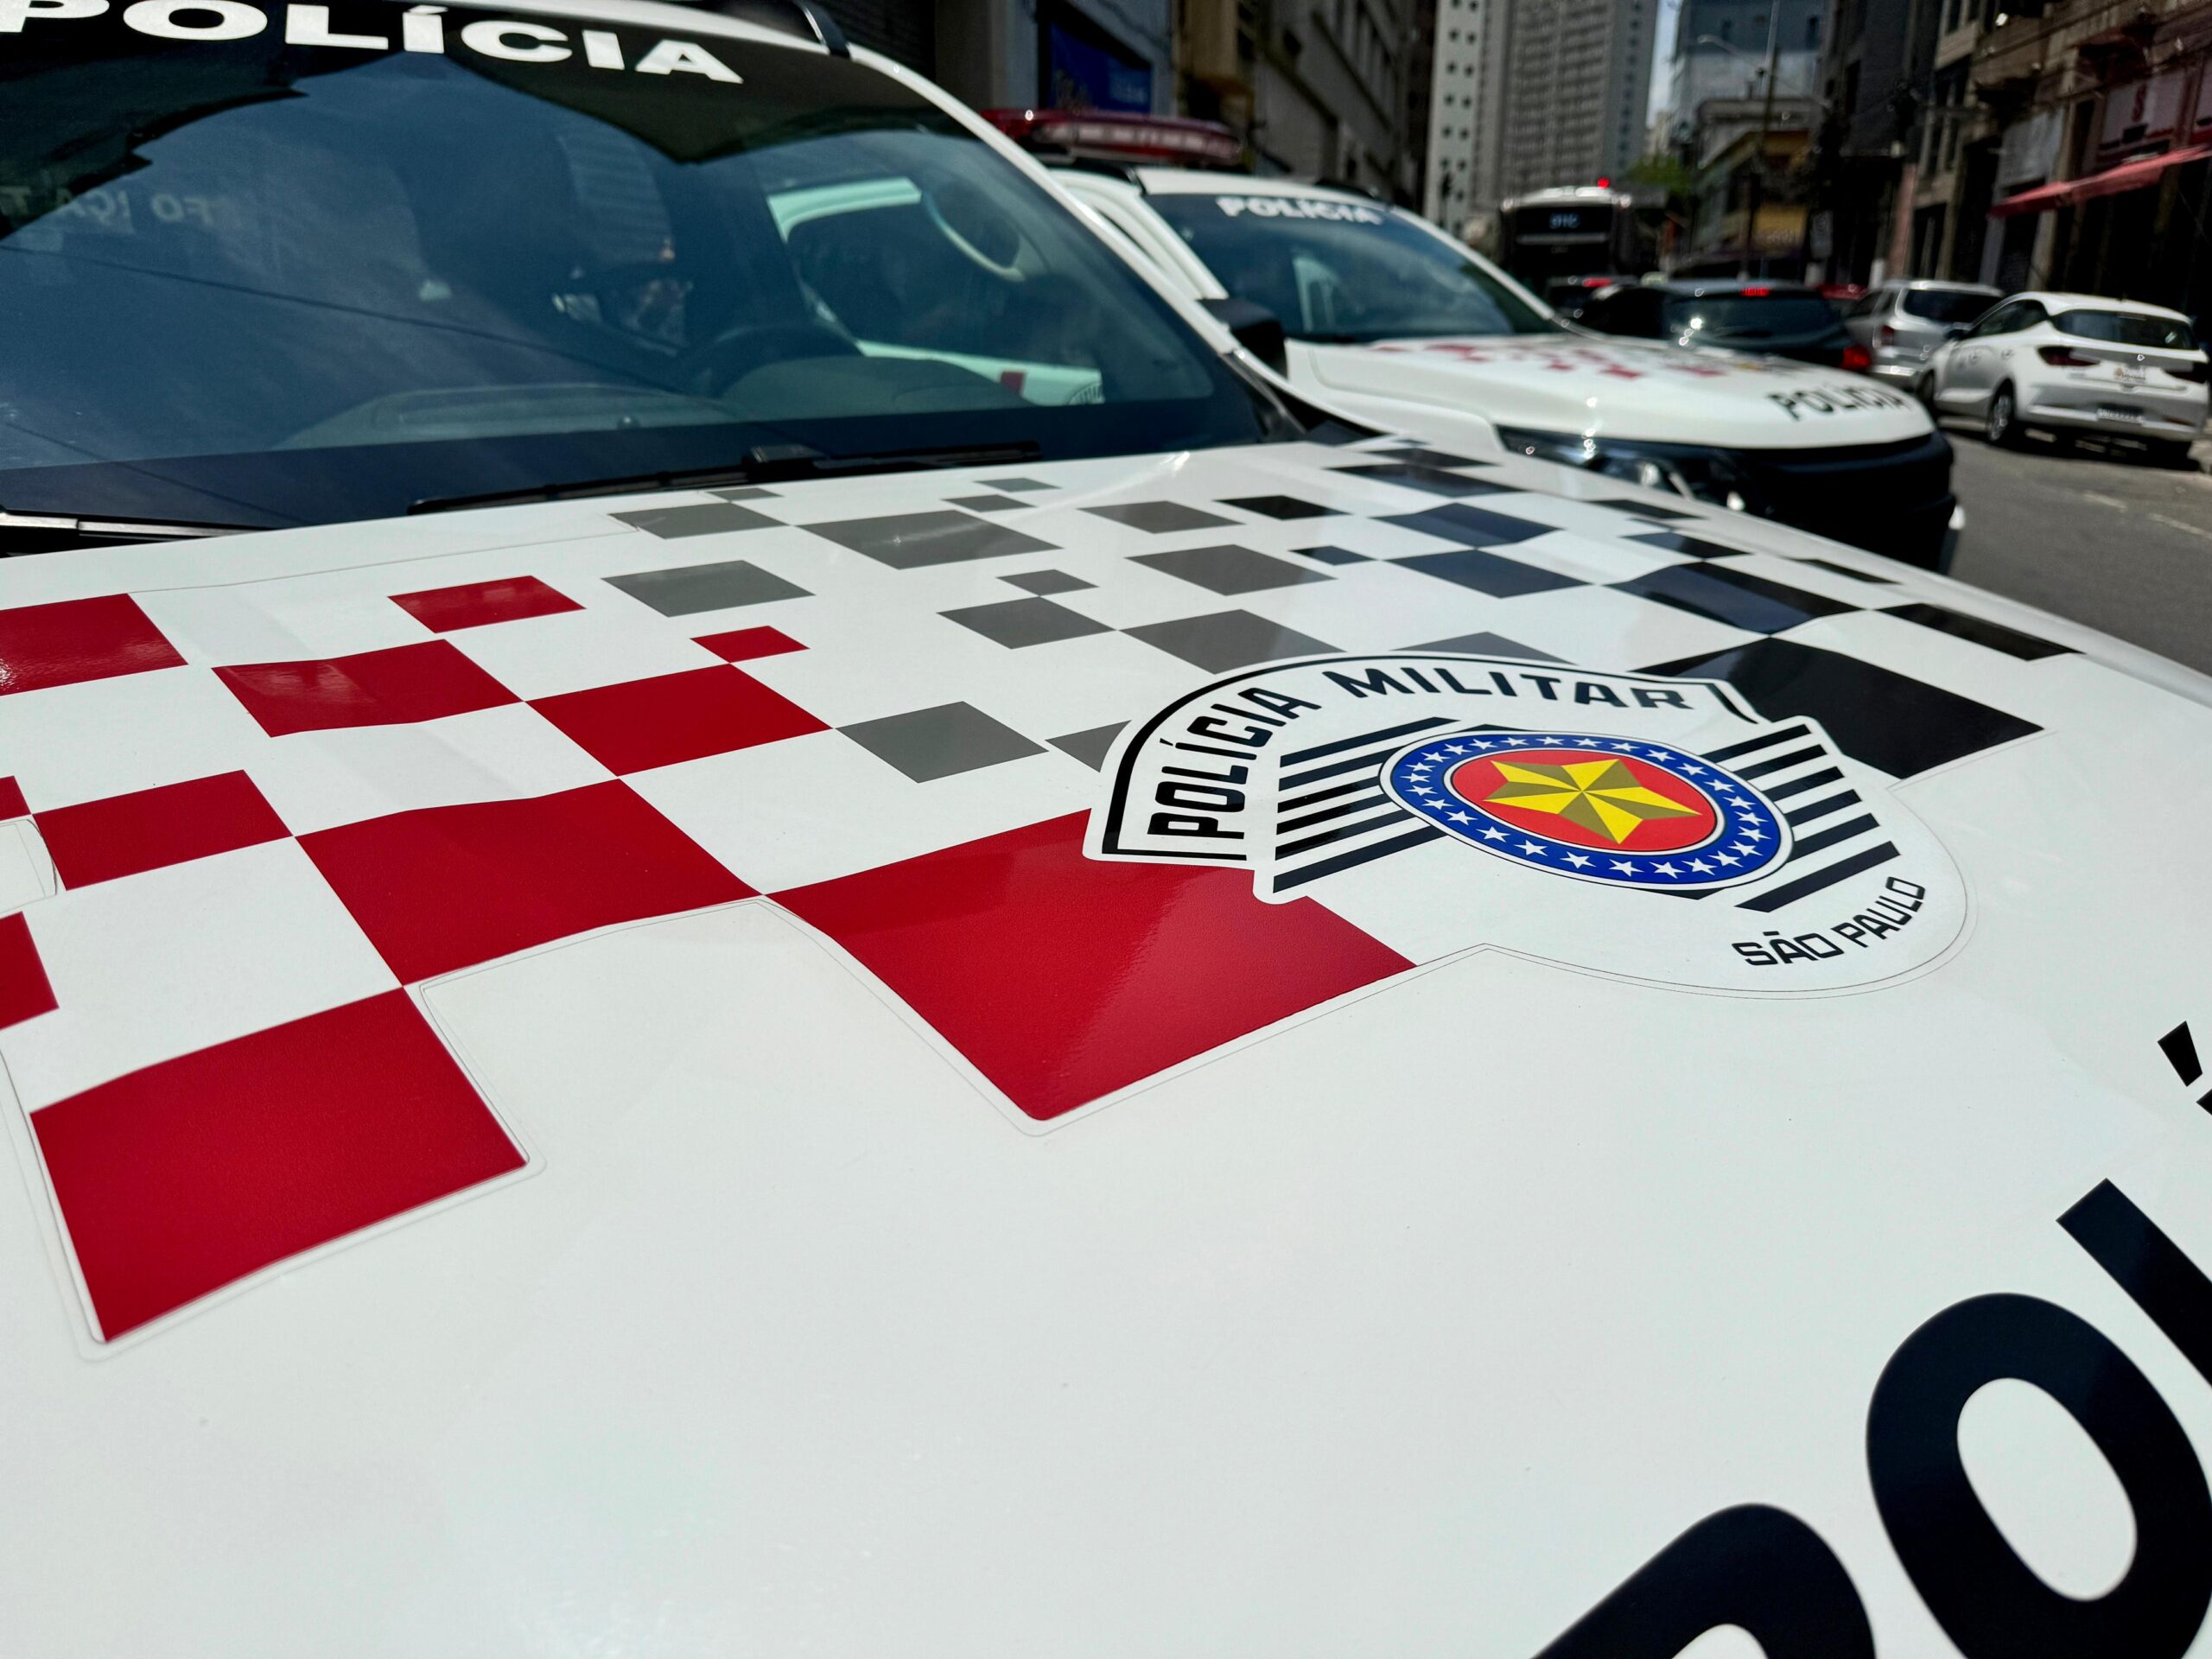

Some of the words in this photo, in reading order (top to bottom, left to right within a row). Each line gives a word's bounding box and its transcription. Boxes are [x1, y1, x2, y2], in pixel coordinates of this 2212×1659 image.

[0, 0, 743, 84] POLÍCIA
[1147, 686, 1322, 840] POLÍCIA
[1322, 665, 1694, 710] MILITAR
[1731, 931, 1845, 966] SÃO
[1830, 876, 1926, 949] PAULO
